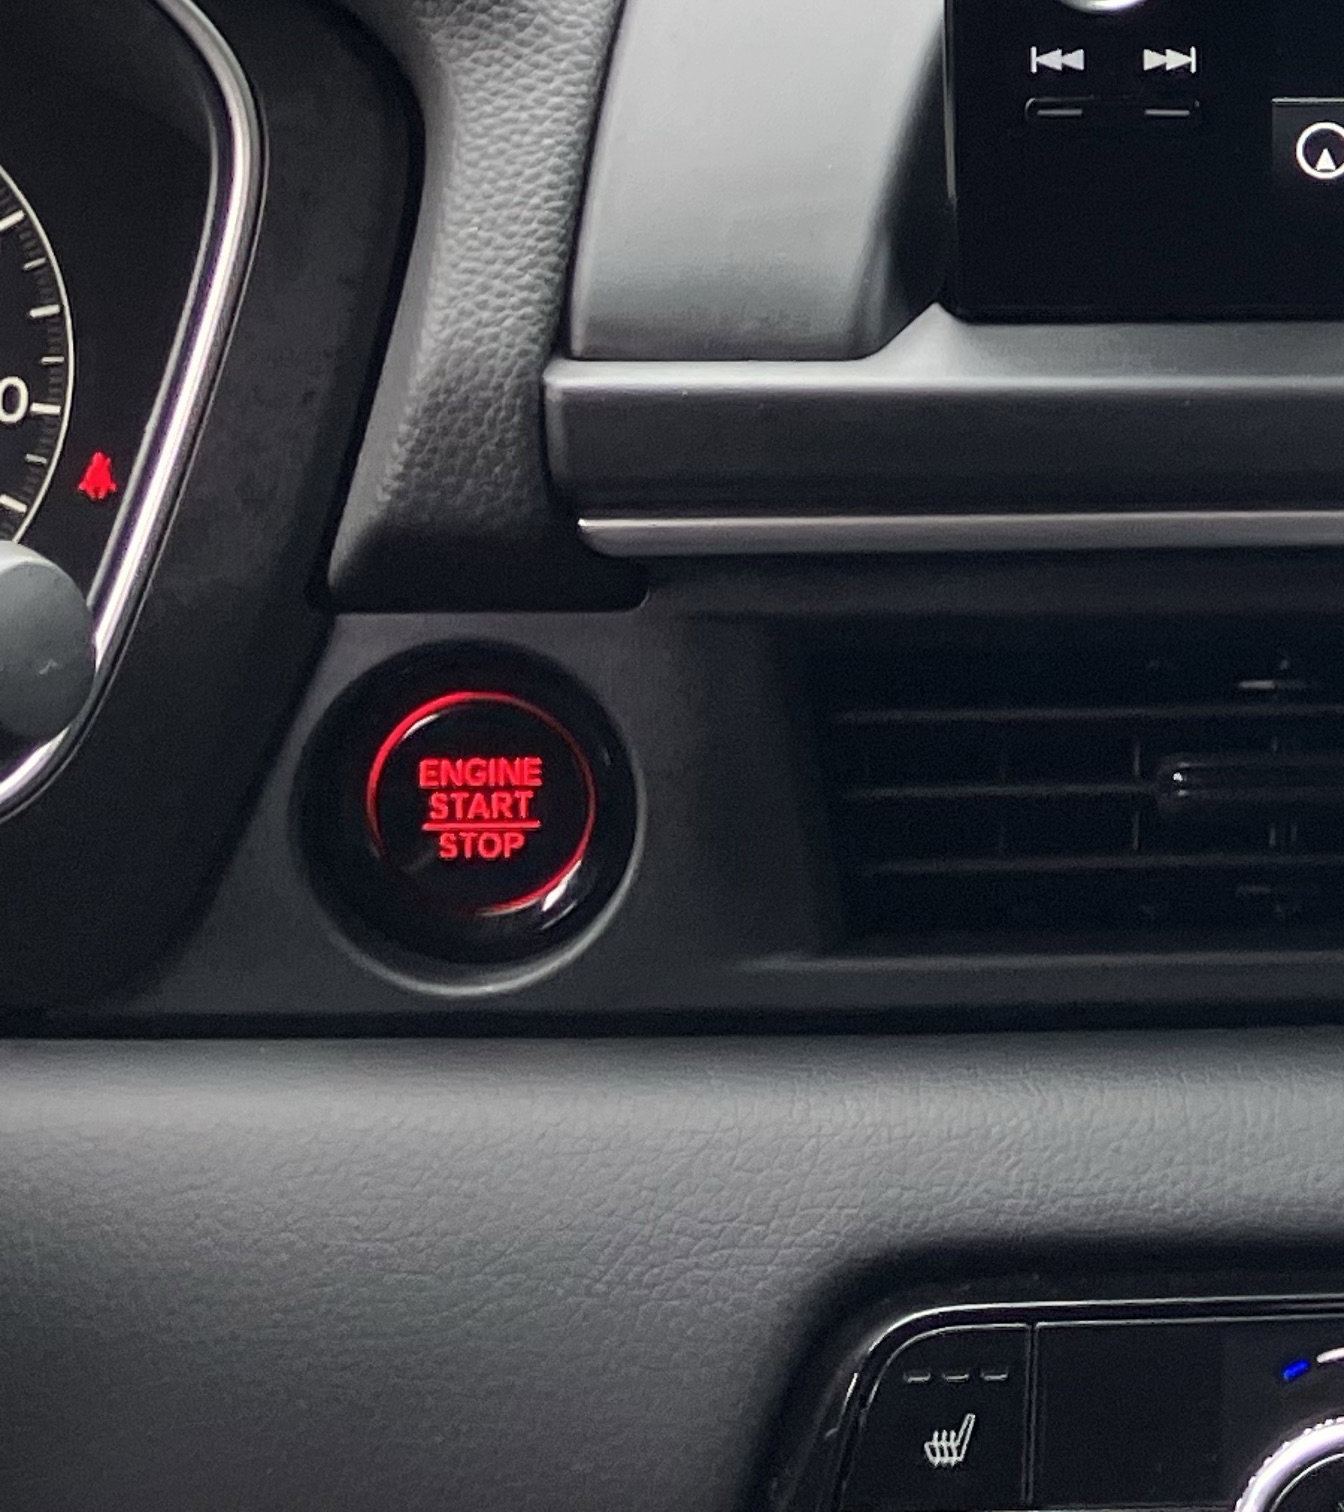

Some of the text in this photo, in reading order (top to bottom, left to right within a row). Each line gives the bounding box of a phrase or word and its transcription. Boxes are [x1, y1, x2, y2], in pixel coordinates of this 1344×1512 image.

[418, 757, 543, 788] ENGINE
[428, 790, 535, 821] START
[437, 829, 525, 860] STOP
